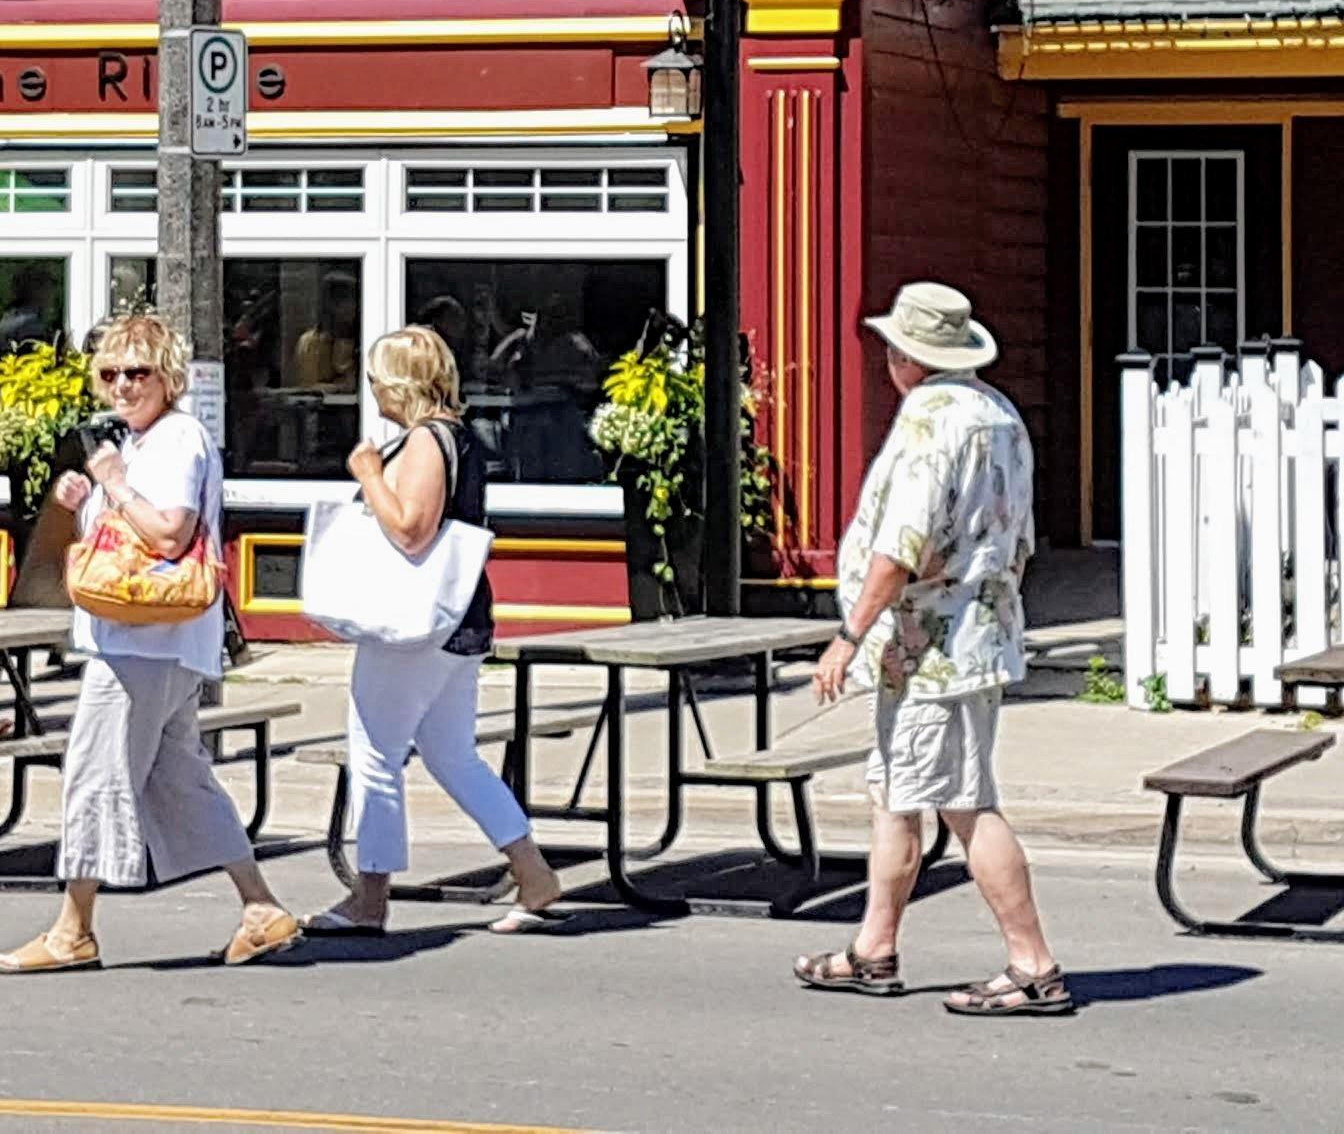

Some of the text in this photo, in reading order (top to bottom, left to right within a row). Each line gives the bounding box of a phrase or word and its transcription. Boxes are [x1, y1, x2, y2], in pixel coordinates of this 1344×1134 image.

[98, 52, 286, 103] Rie
[211, 51, 227, 81] P
[206, 96, 214, 113] 2
